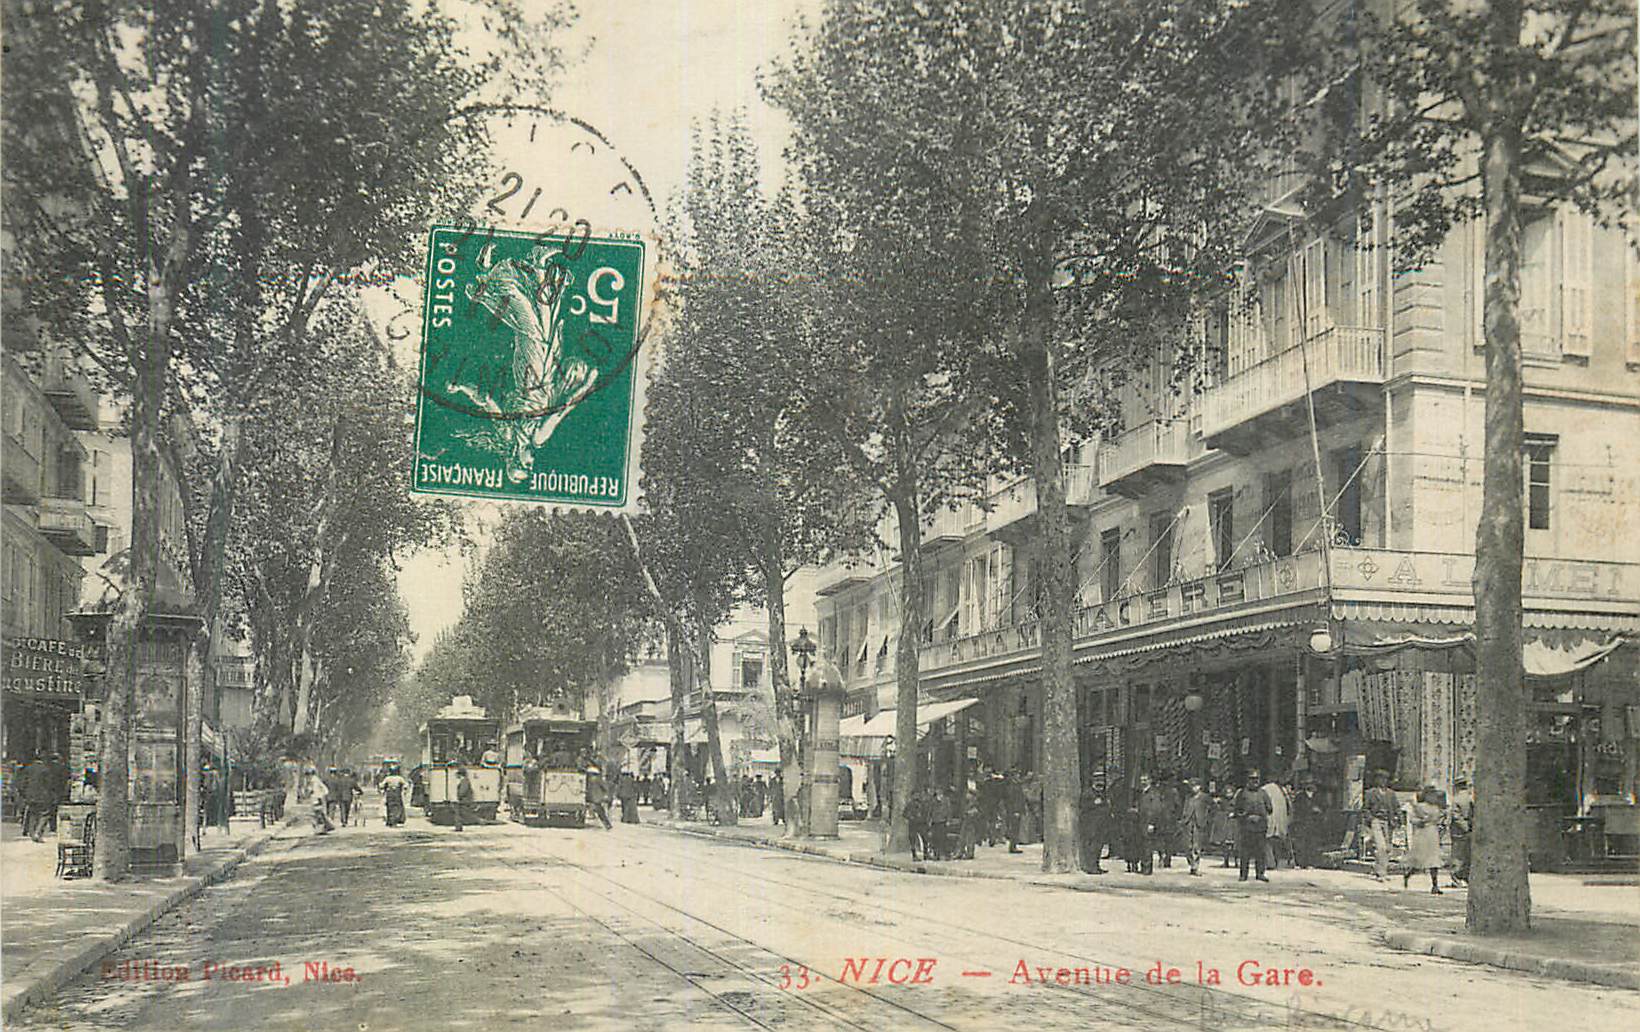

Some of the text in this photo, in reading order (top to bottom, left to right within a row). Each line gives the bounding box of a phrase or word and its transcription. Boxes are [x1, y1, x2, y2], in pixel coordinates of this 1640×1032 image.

[431, 242, 457, 328] POSTES
[421, 463, 620, 496] REPUBLIQUE FRANÇAISE
